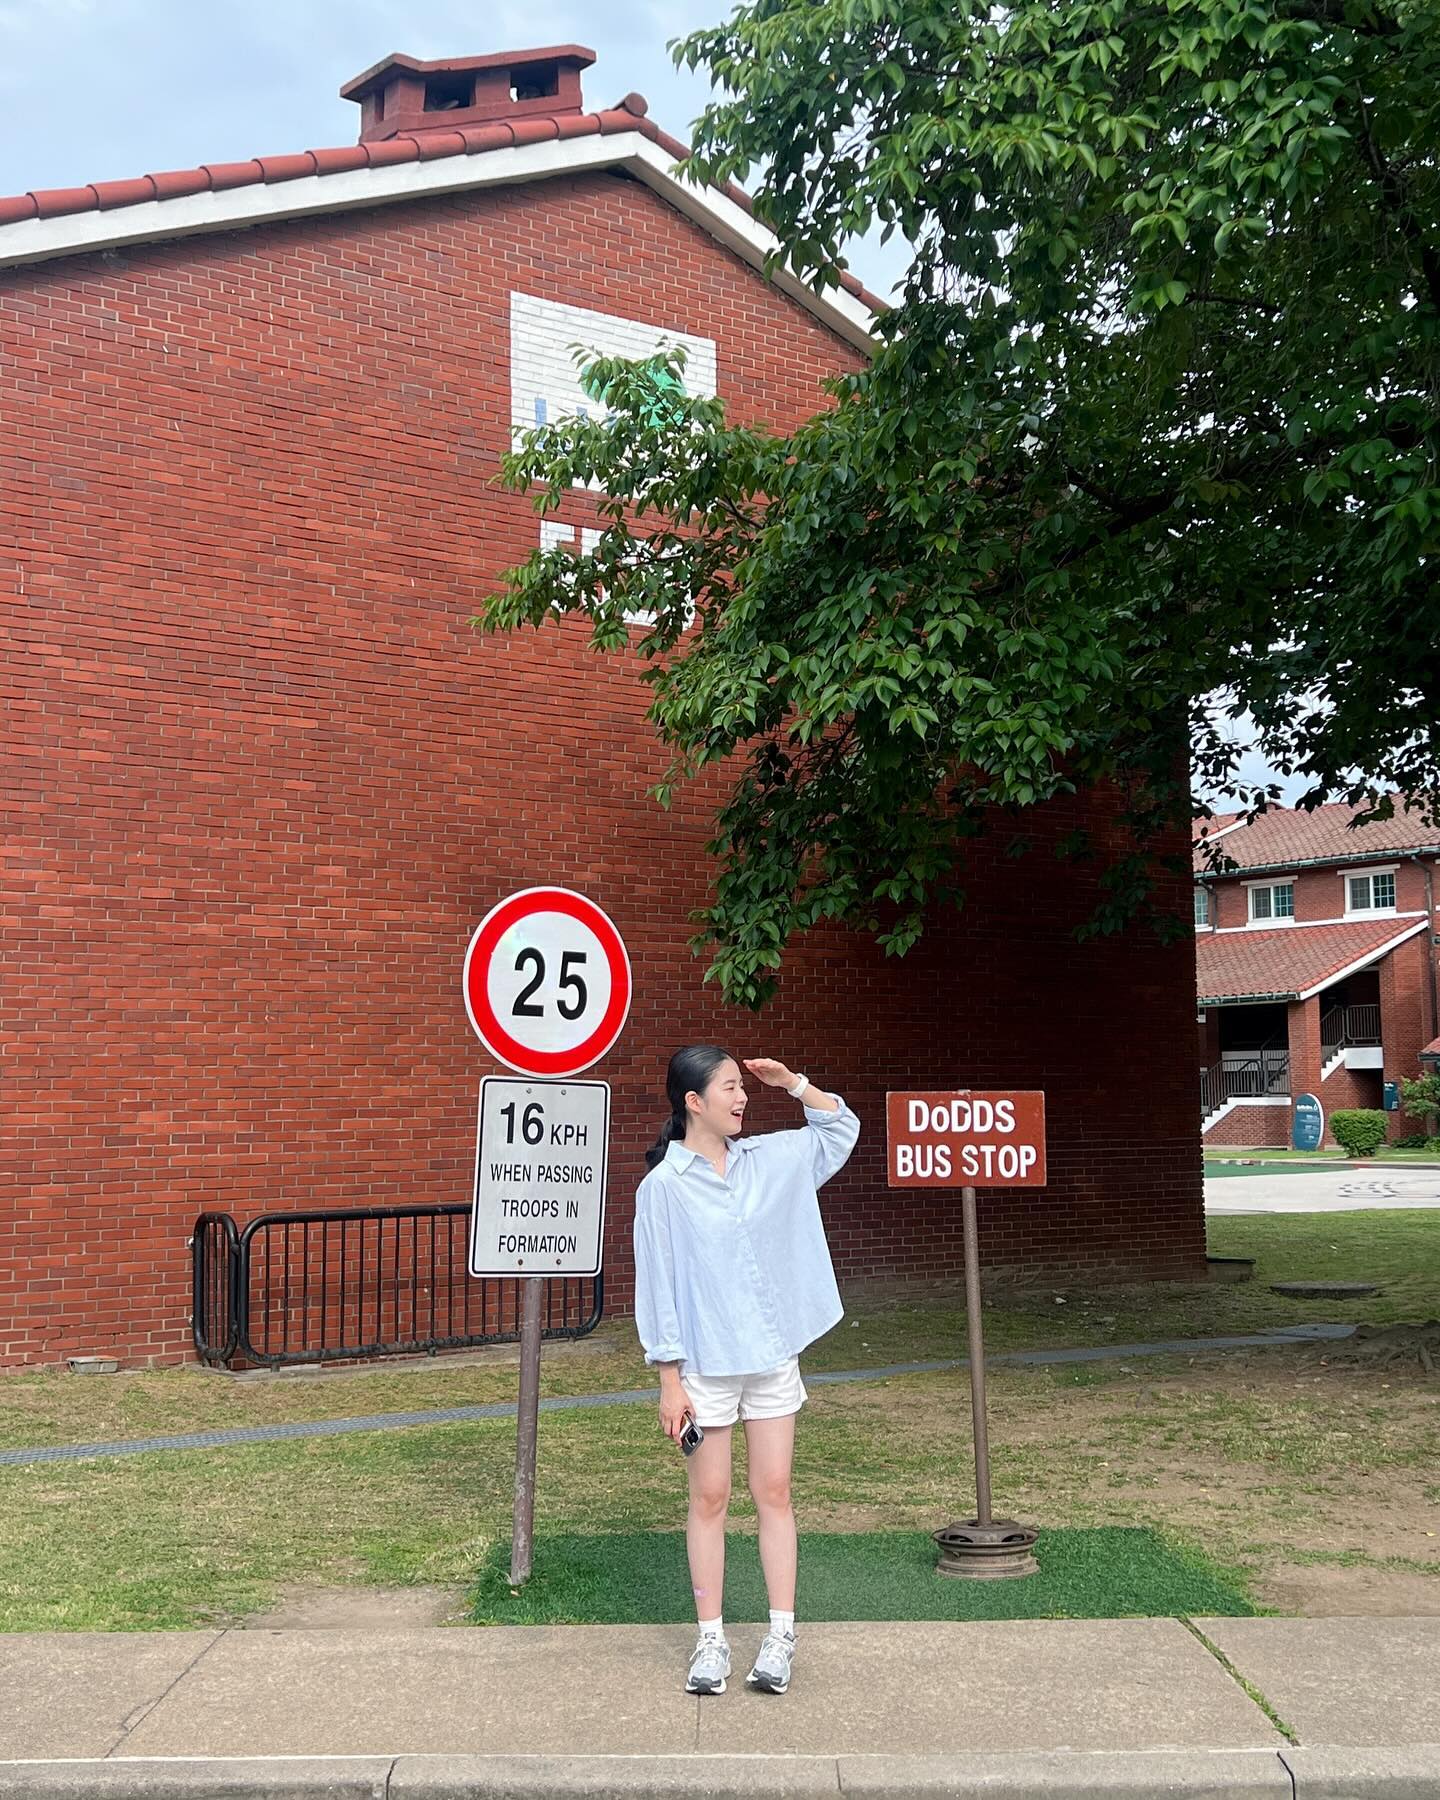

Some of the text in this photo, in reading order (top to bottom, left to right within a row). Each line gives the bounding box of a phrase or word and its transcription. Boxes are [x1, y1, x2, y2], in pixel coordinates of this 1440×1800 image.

[512, 948, 587, 1020] 25
[501, 1102, 587, 1146] 16 KPH
[909, 1100, 1015, 1132] DoDDS
[491, 1164, 592, 1183] WHEN PASSING
[897, 1145, 1036, 1178] BUS STOP
[502, 1200, 578, 1218] TROOPS IN
[499, 1235, 576, 1253] FORMATION
